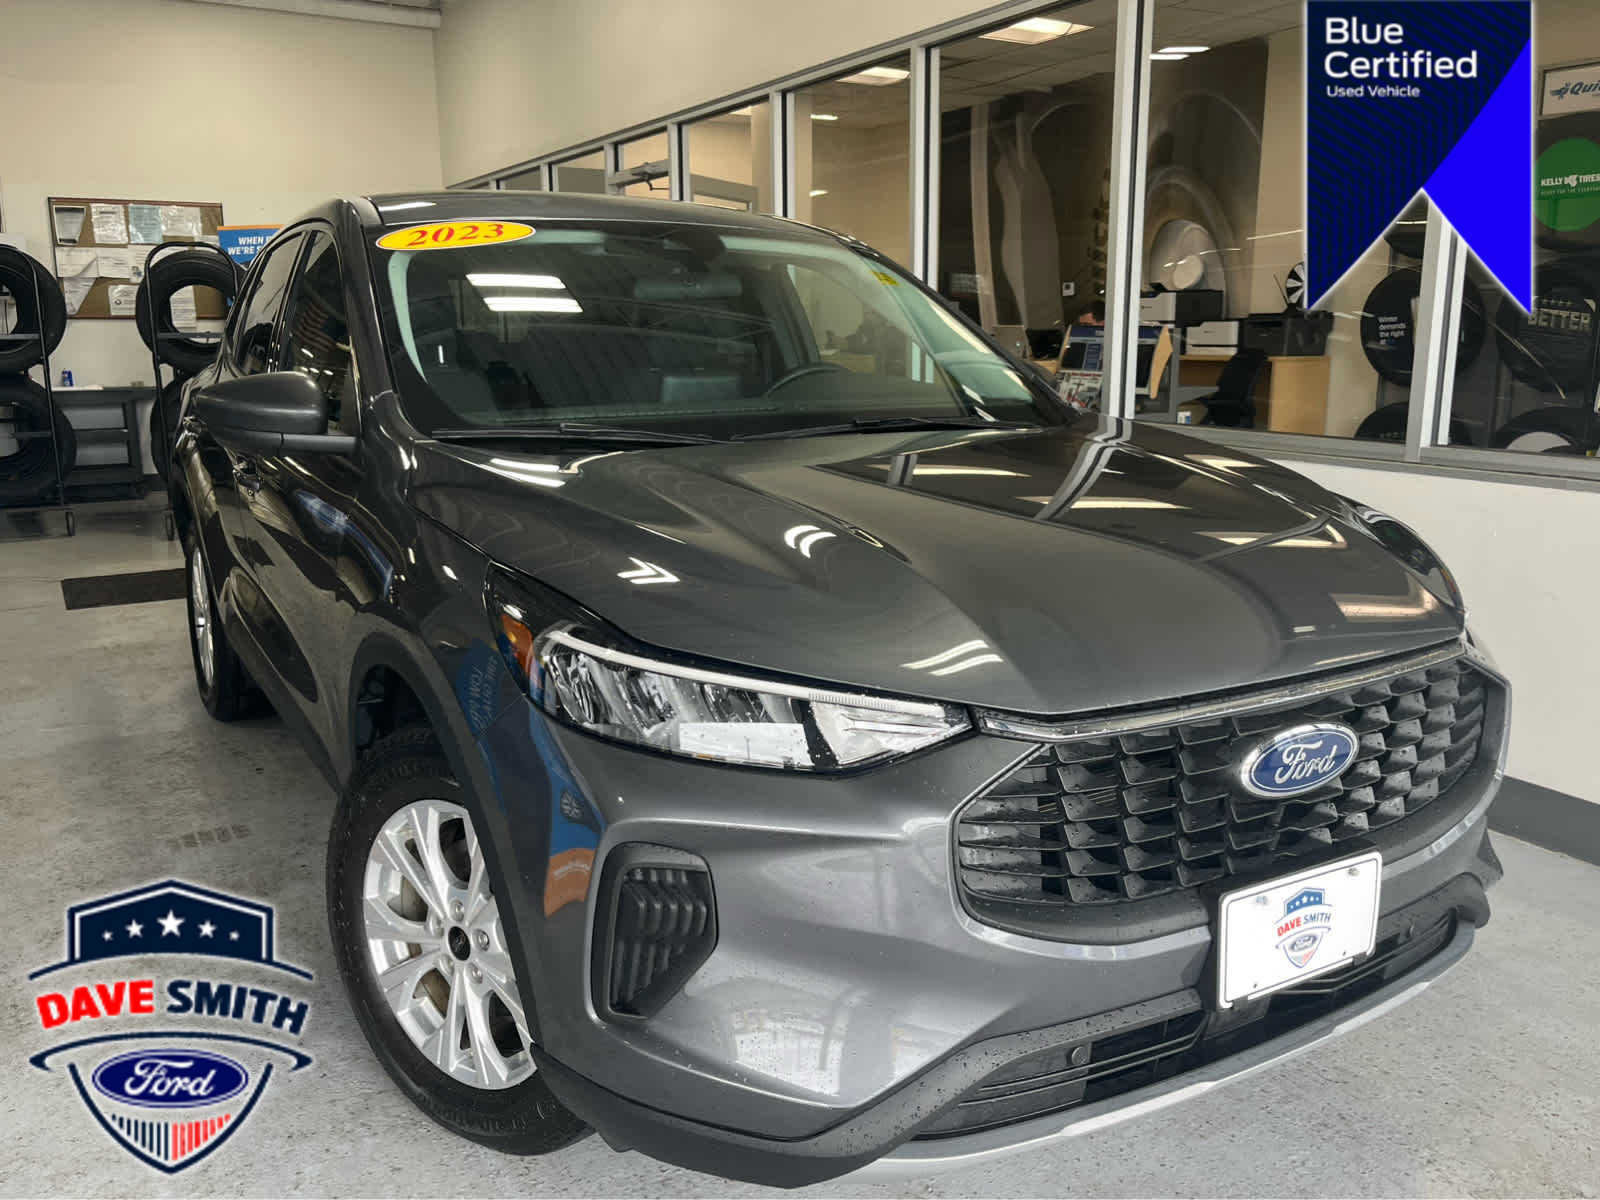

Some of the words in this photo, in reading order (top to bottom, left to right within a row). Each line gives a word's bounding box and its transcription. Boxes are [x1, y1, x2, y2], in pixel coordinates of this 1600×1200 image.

[1540, 176, 1563, 187] KELLY
[238, 235, 264, 246] WHEN
[407, 223, 504, 247] 2023
[227, 245, 255, 256] WE'RE
[1274, 739, 1337, 785] Ford
[1277, 916, 1302, 937] DAVE
[1303, 911, 1332, 925] SMITH
